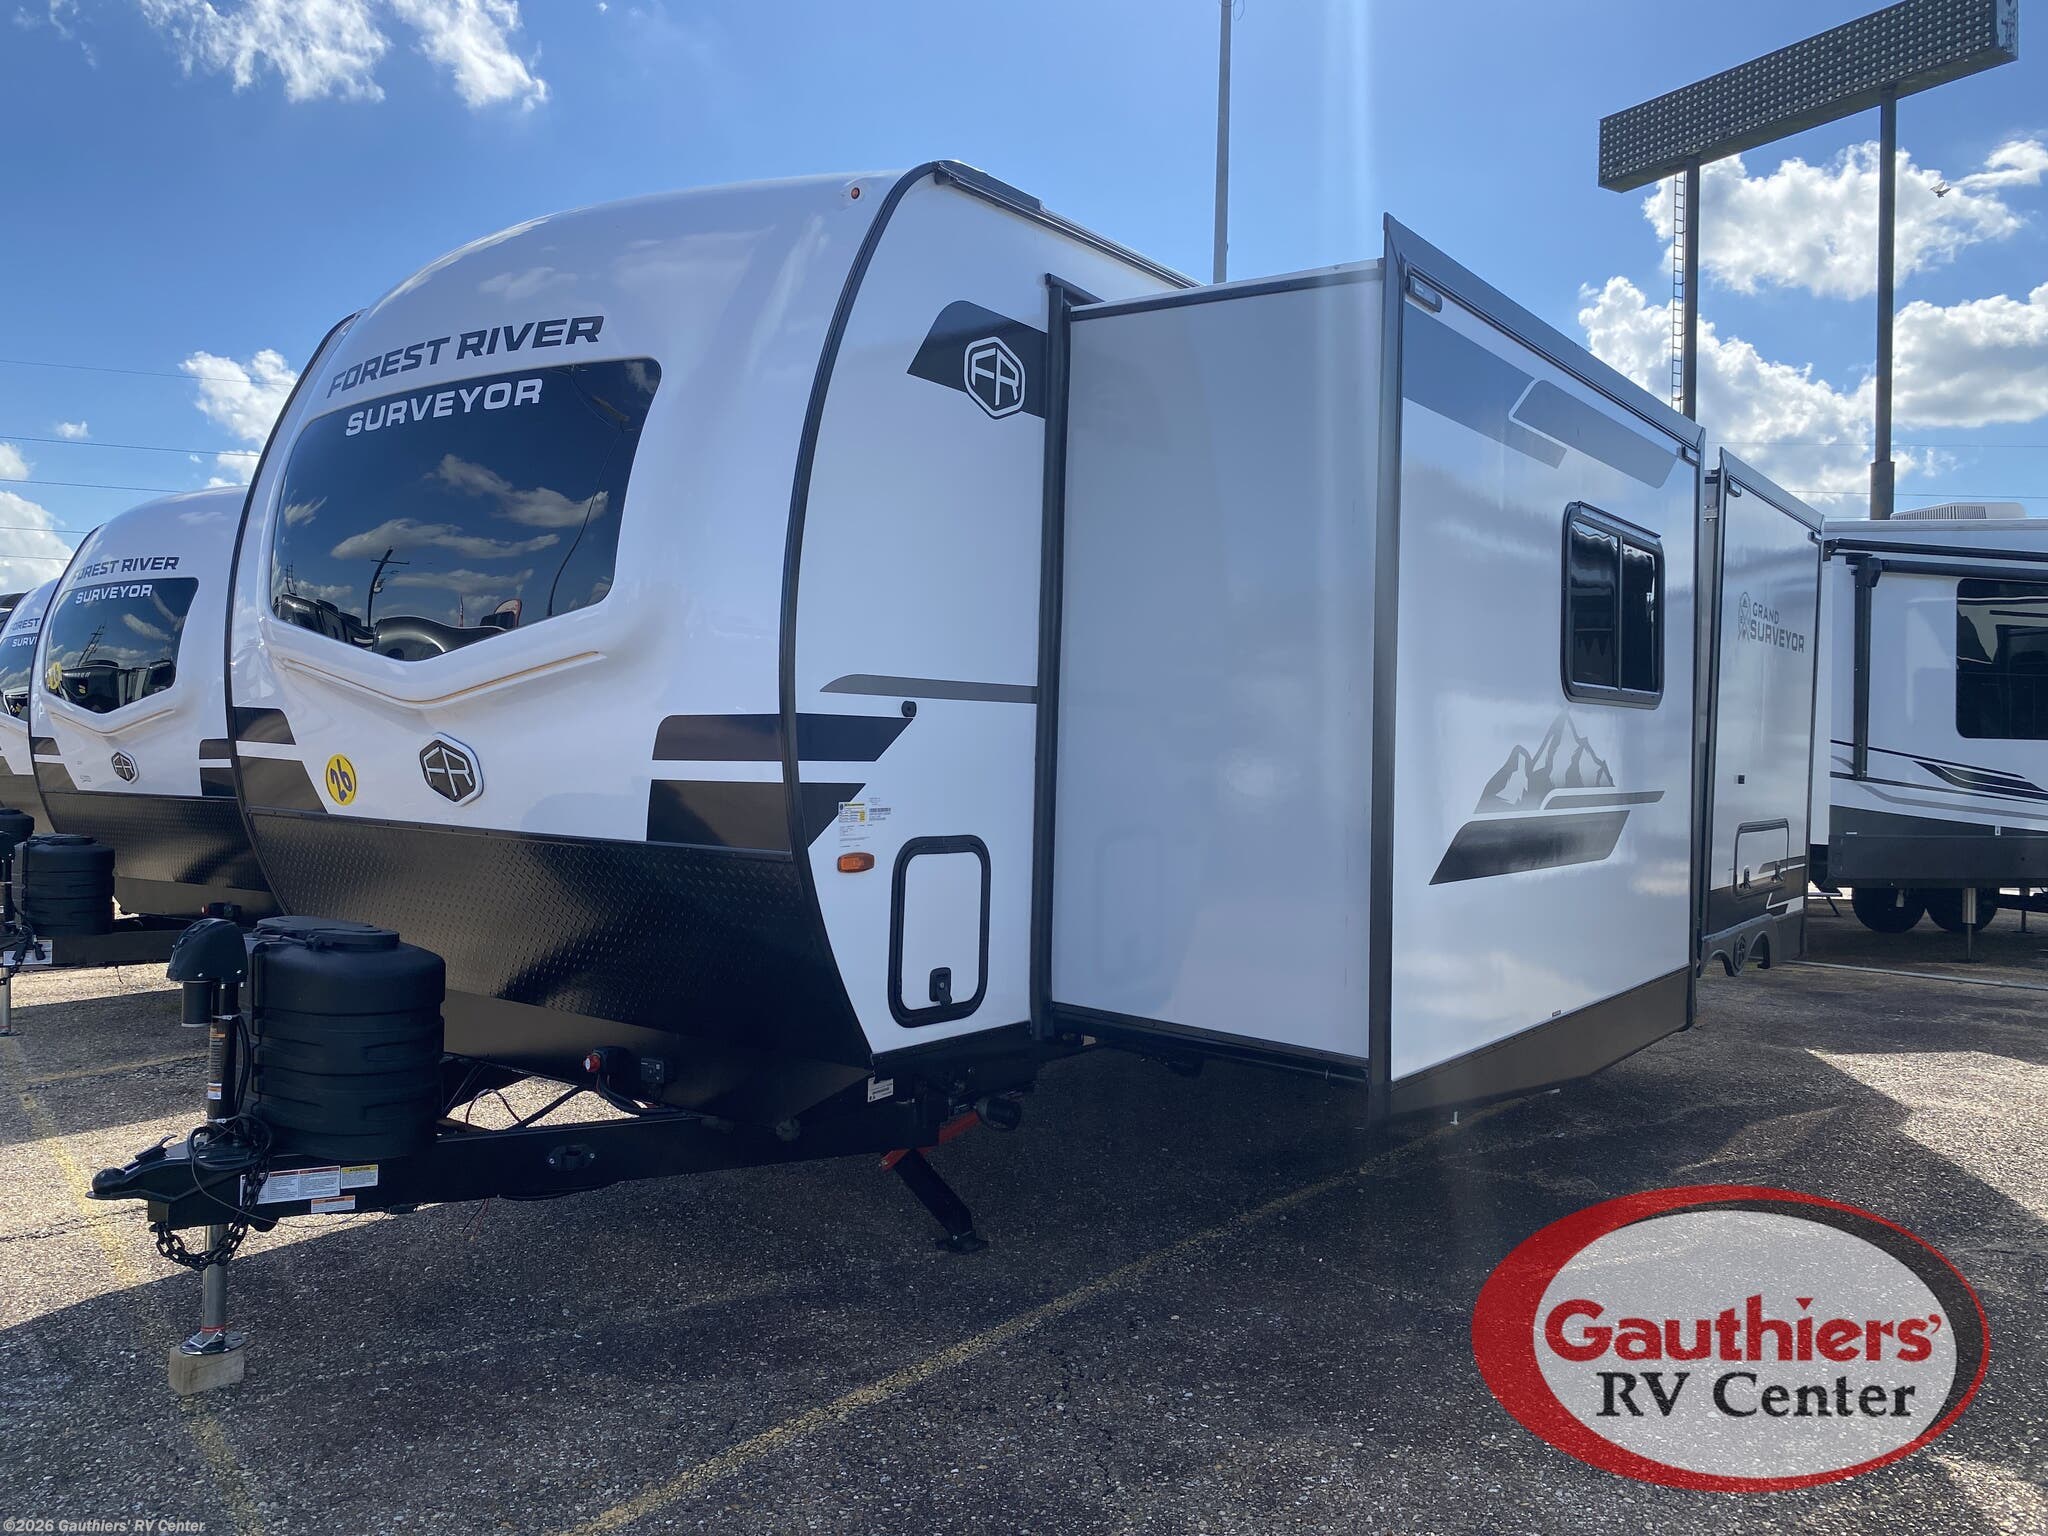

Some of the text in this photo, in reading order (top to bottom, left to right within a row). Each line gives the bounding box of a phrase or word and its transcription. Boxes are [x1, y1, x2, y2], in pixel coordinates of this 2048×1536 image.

[327, 315, 605, 399] FOREST RIVER
[345, 378, 544, 437] SURVEYOR
[73, 556, 180, 581] FOREST RIVER
[75, 584, 153, 604] SURVEYOR
[1752, 602, 1780, 625] GRAND
[12, 636, 38, 648] SURV
[1749, 619, 1805, 653] SURVEYOR
[330, 758, 353, 802] 26
